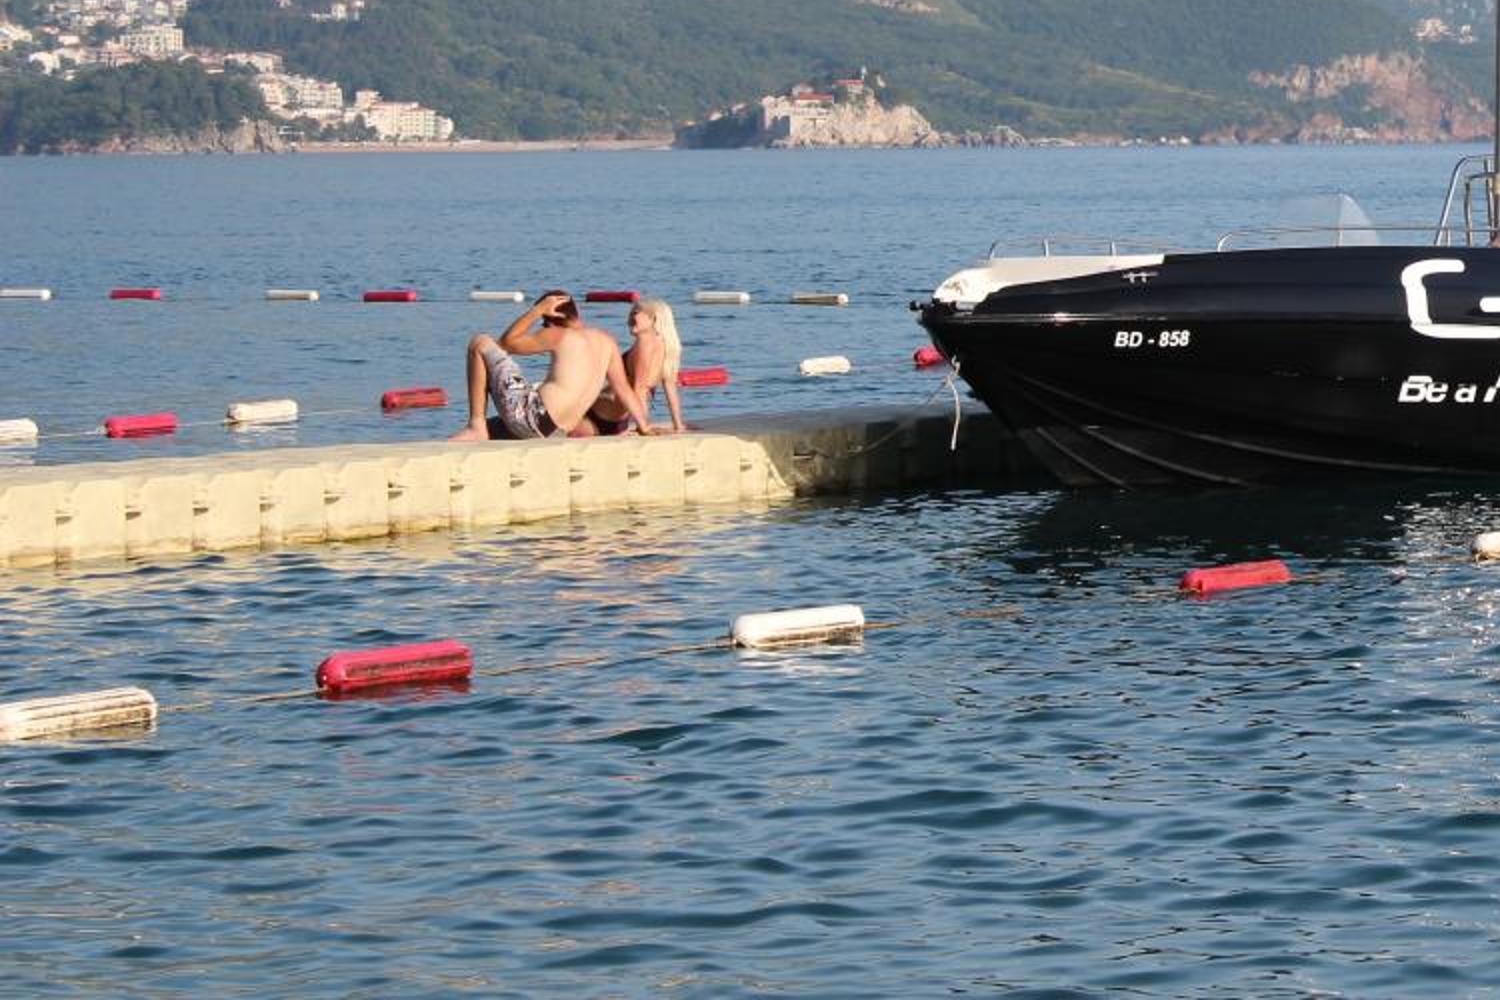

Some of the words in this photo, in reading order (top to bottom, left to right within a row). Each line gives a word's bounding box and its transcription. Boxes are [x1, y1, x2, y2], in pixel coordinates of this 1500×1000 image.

[1113, 331, 1144, 348] BD
[1158, 329, 1191, 348] 858
[1397, 375, 1449, 403] Be
[1454, 383, 1478, 403] a
